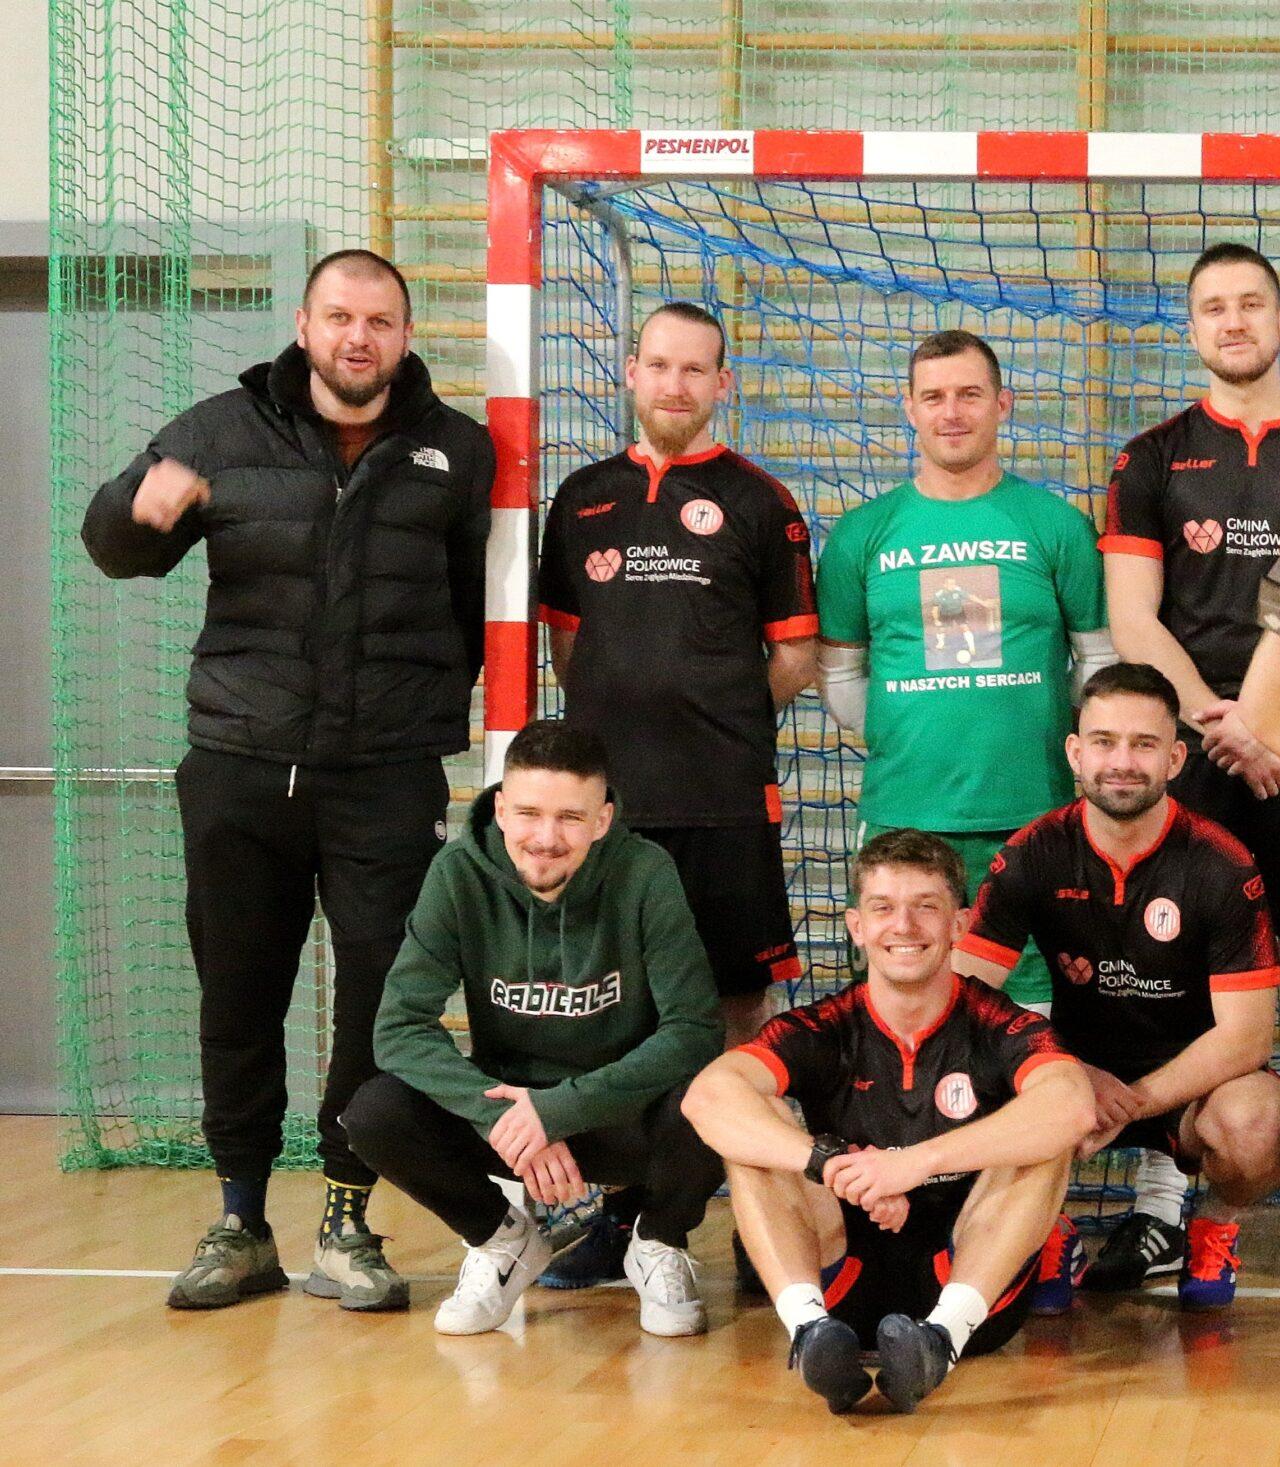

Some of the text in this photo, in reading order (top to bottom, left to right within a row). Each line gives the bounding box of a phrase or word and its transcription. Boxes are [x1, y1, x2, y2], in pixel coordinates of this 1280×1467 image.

[644, 138, 750, 155] PESMENPOL
[1226, 518, 1270, 532] GMINA
[625, 545, 669, 559] GMINA
[879, 540, 1028, 574] NA ZAWSZE
[1226, 547, 1242, 555] Serce
[625, 558, 702, 573] POLKOWICE
[885, 671, 1042, 693] W NASZYCH SERCACH
[1098, 959, 1137, 976] GMINA
[491, 971, 621, 1017] RADICALS
